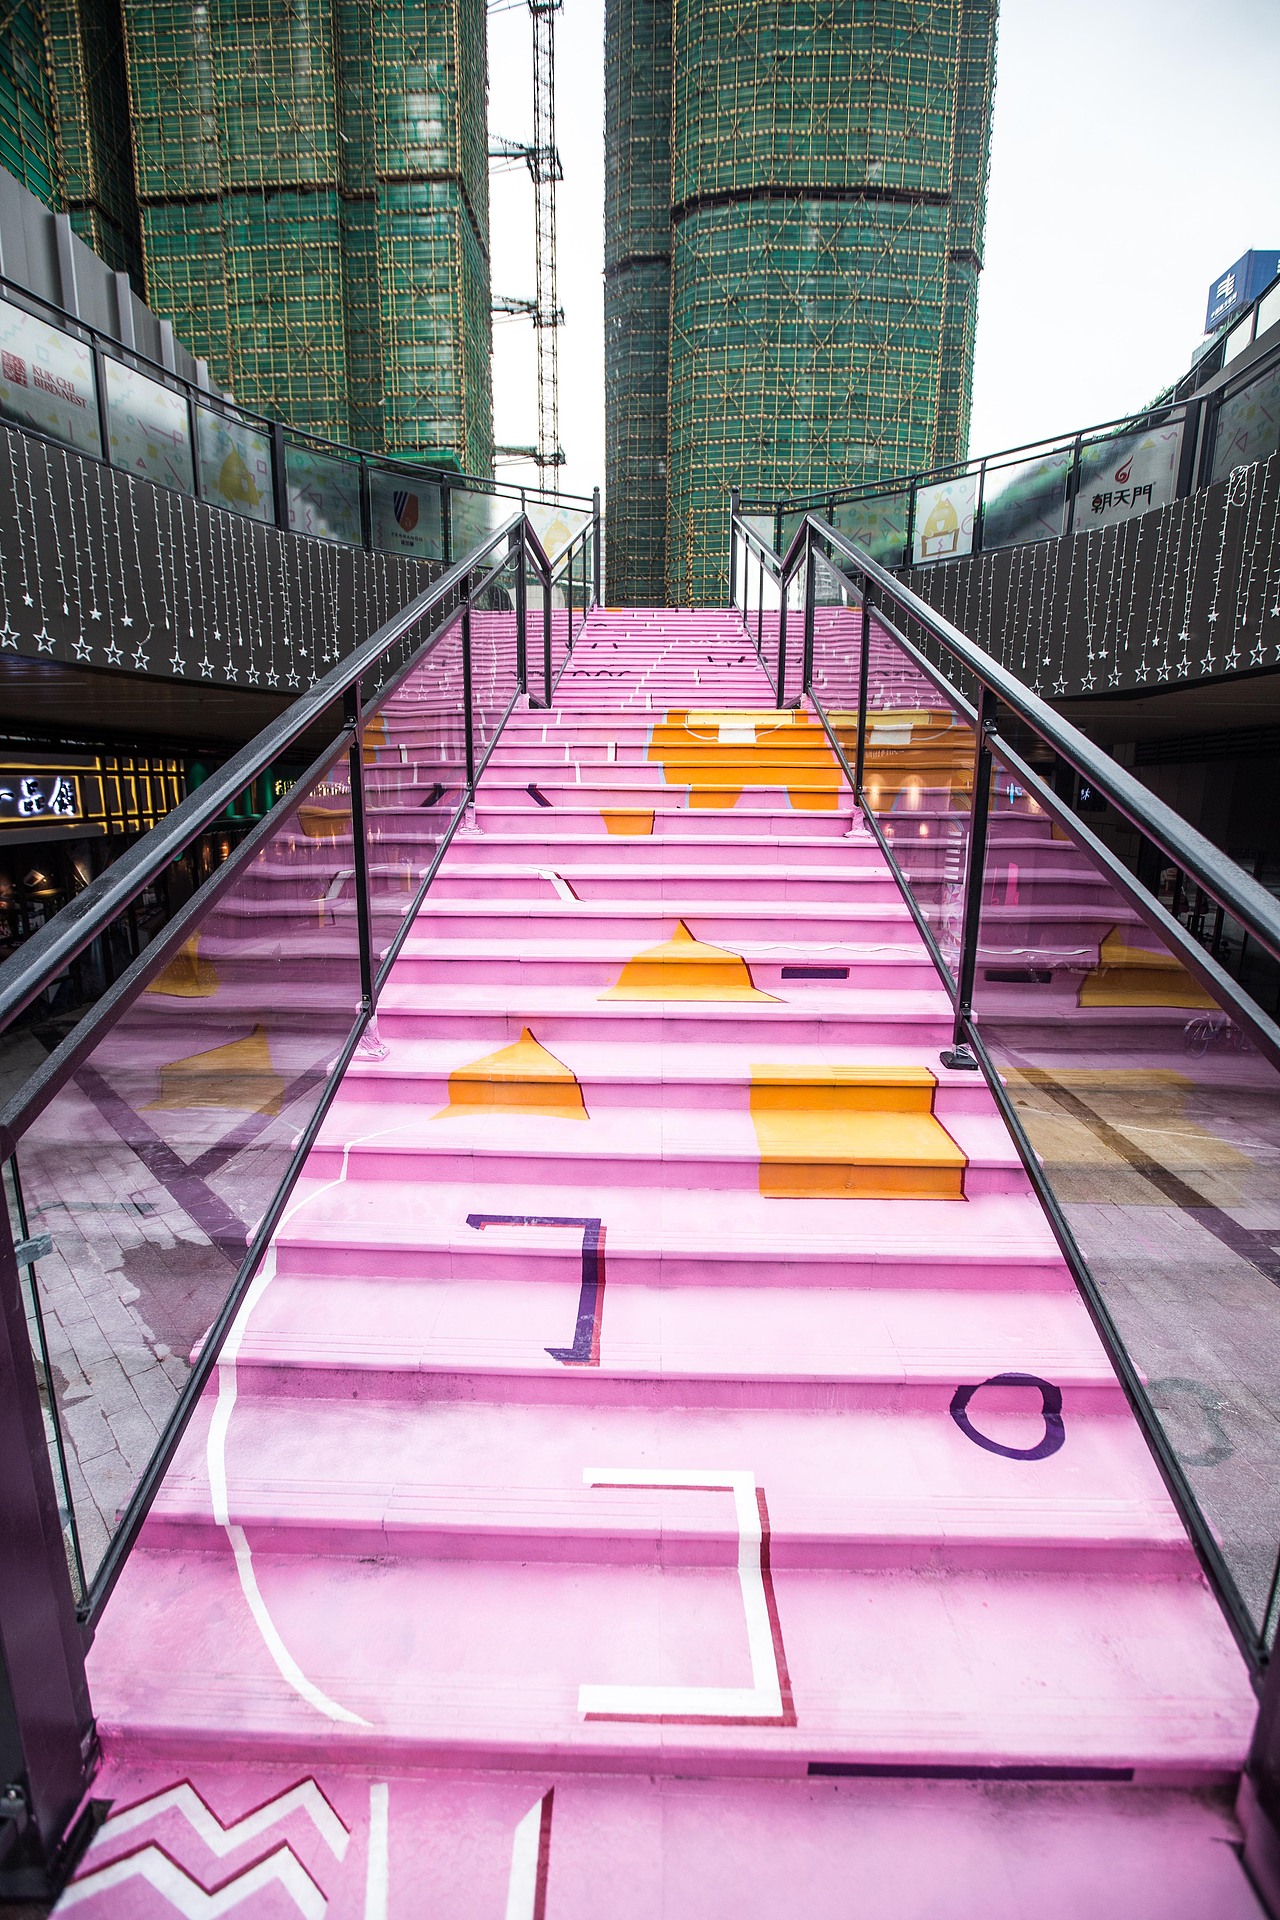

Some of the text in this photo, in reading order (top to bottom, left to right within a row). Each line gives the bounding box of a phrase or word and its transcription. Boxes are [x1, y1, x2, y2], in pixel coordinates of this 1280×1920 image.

[56, 376, 76, 393] CHI
[61, 389, 88, 409] NEST
[1091, 484, 1153, 515] 朝天門
